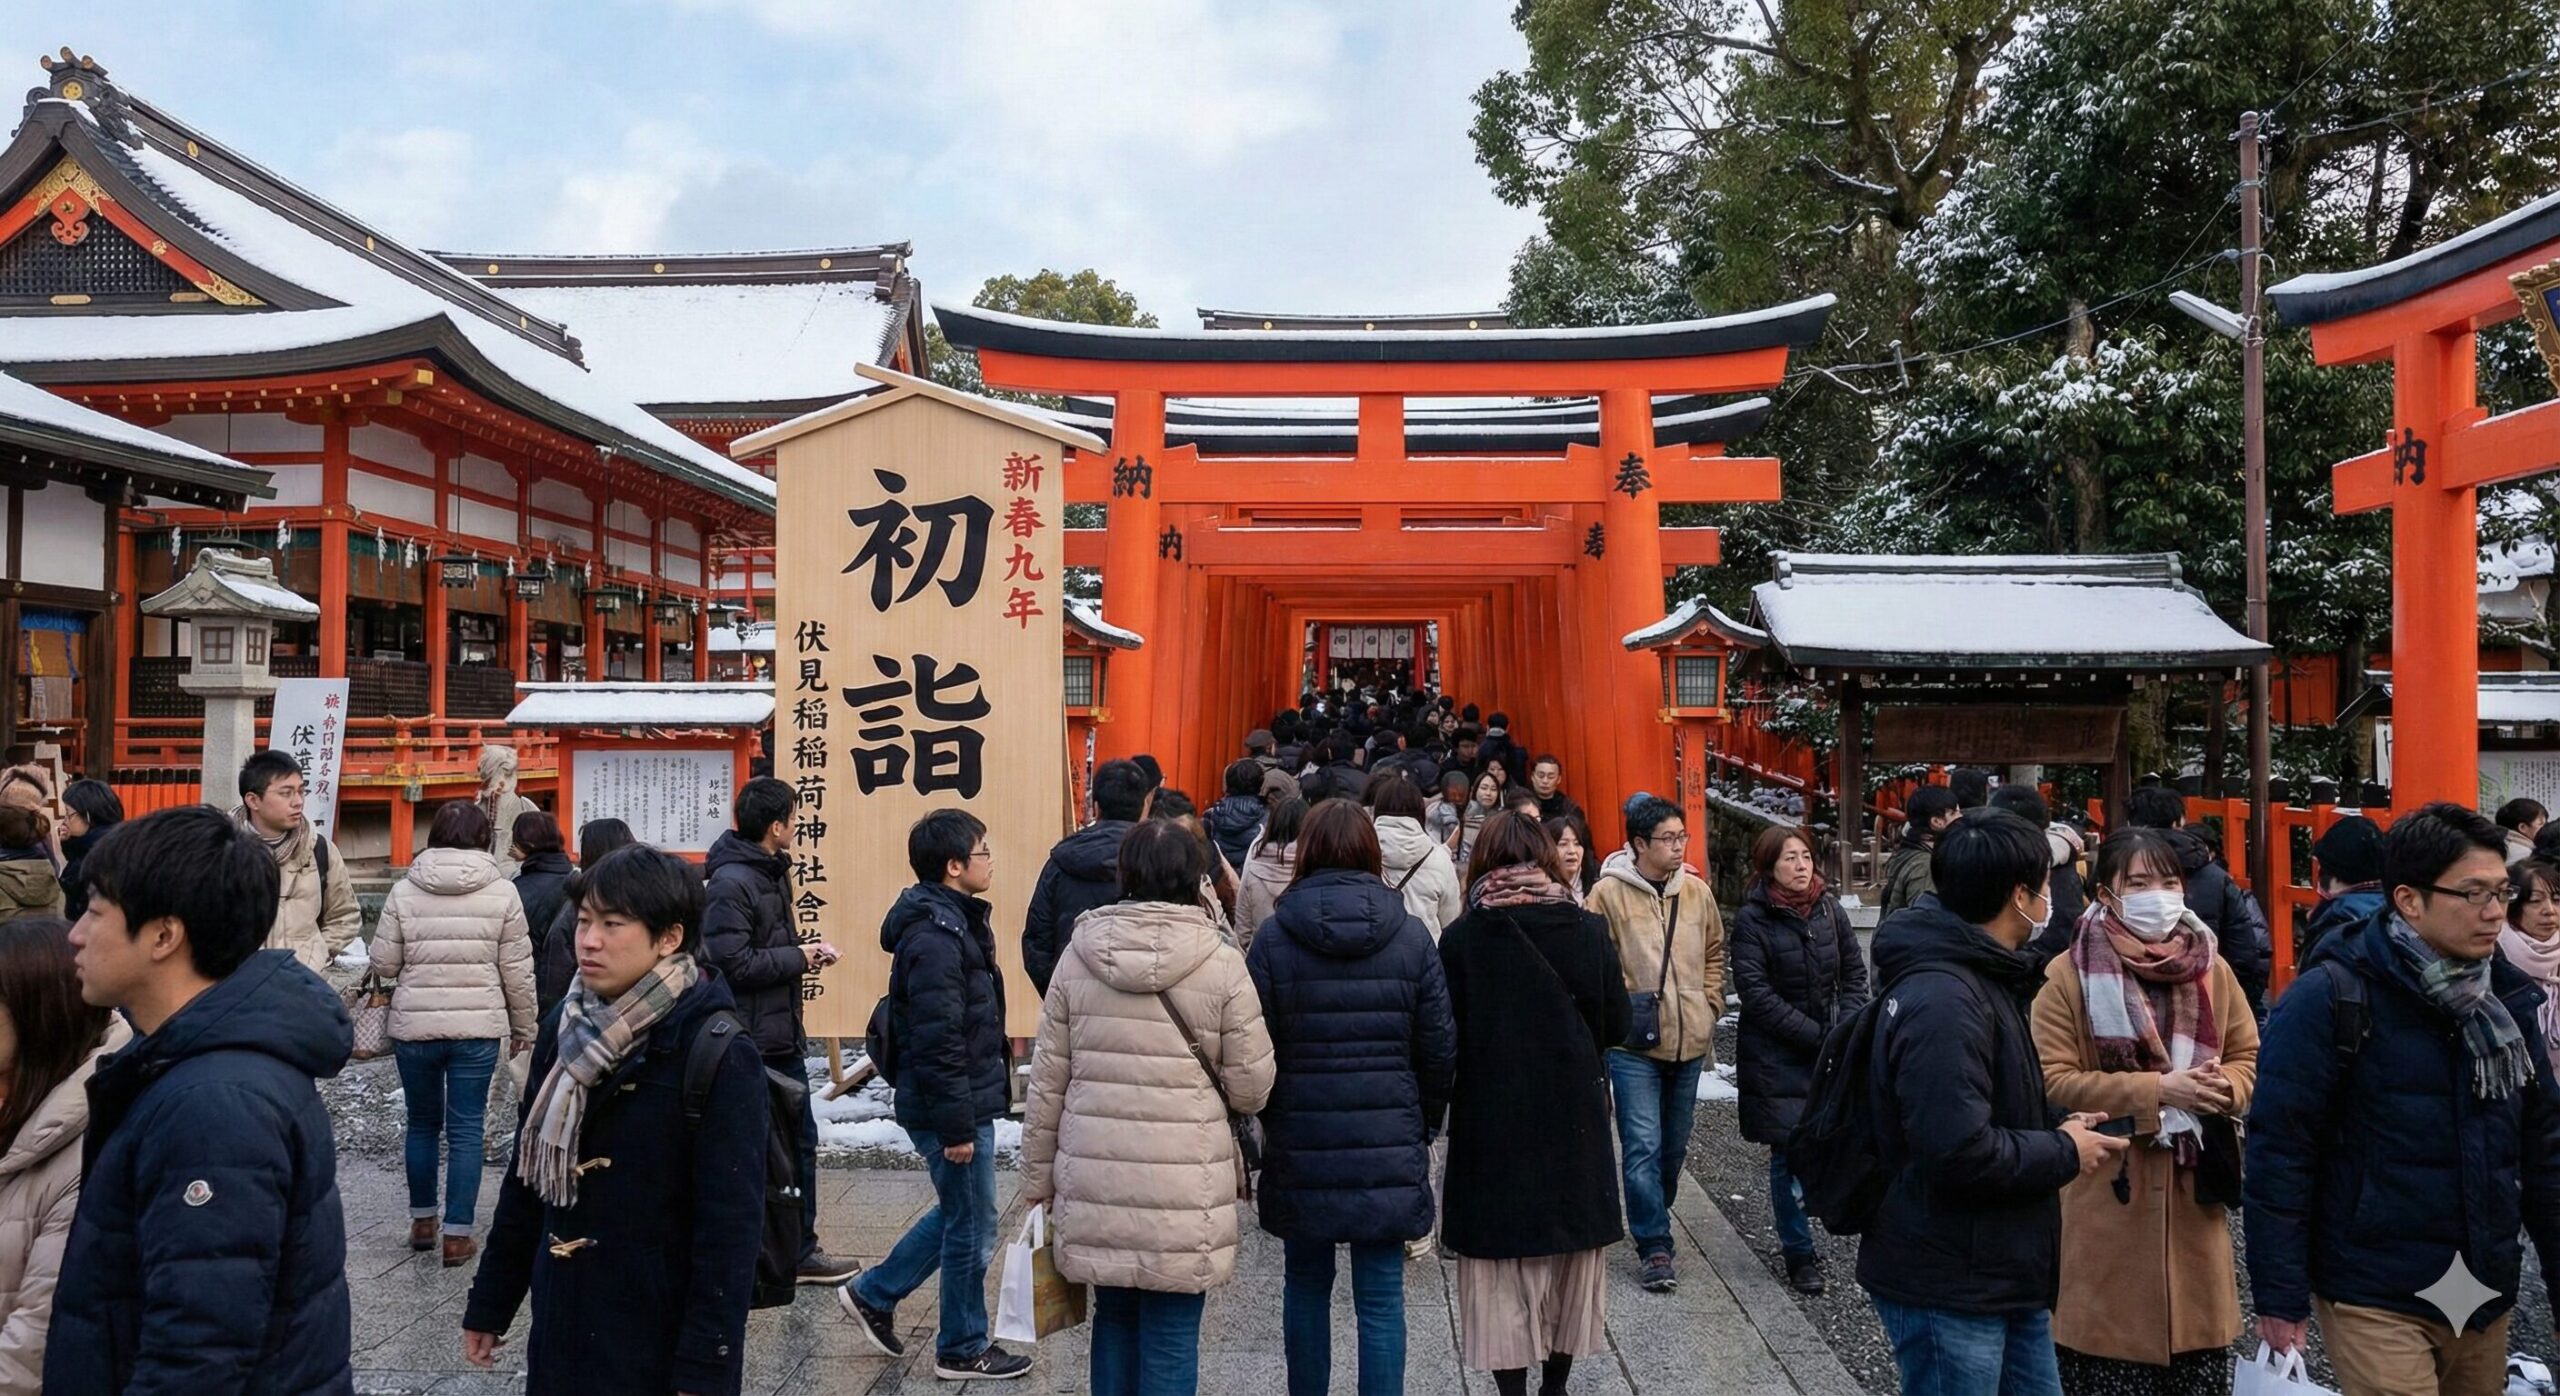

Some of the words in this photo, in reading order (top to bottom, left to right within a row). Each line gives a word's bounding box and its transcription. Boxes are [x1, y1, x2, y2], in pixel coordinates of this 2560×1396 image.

[1113, 454, 1153, 499] 納
[1613, 451, 1653, 500] 奉
[1002, 451, 1045, 630] 新春九年
[841, 468, 995, 800] 初詣
